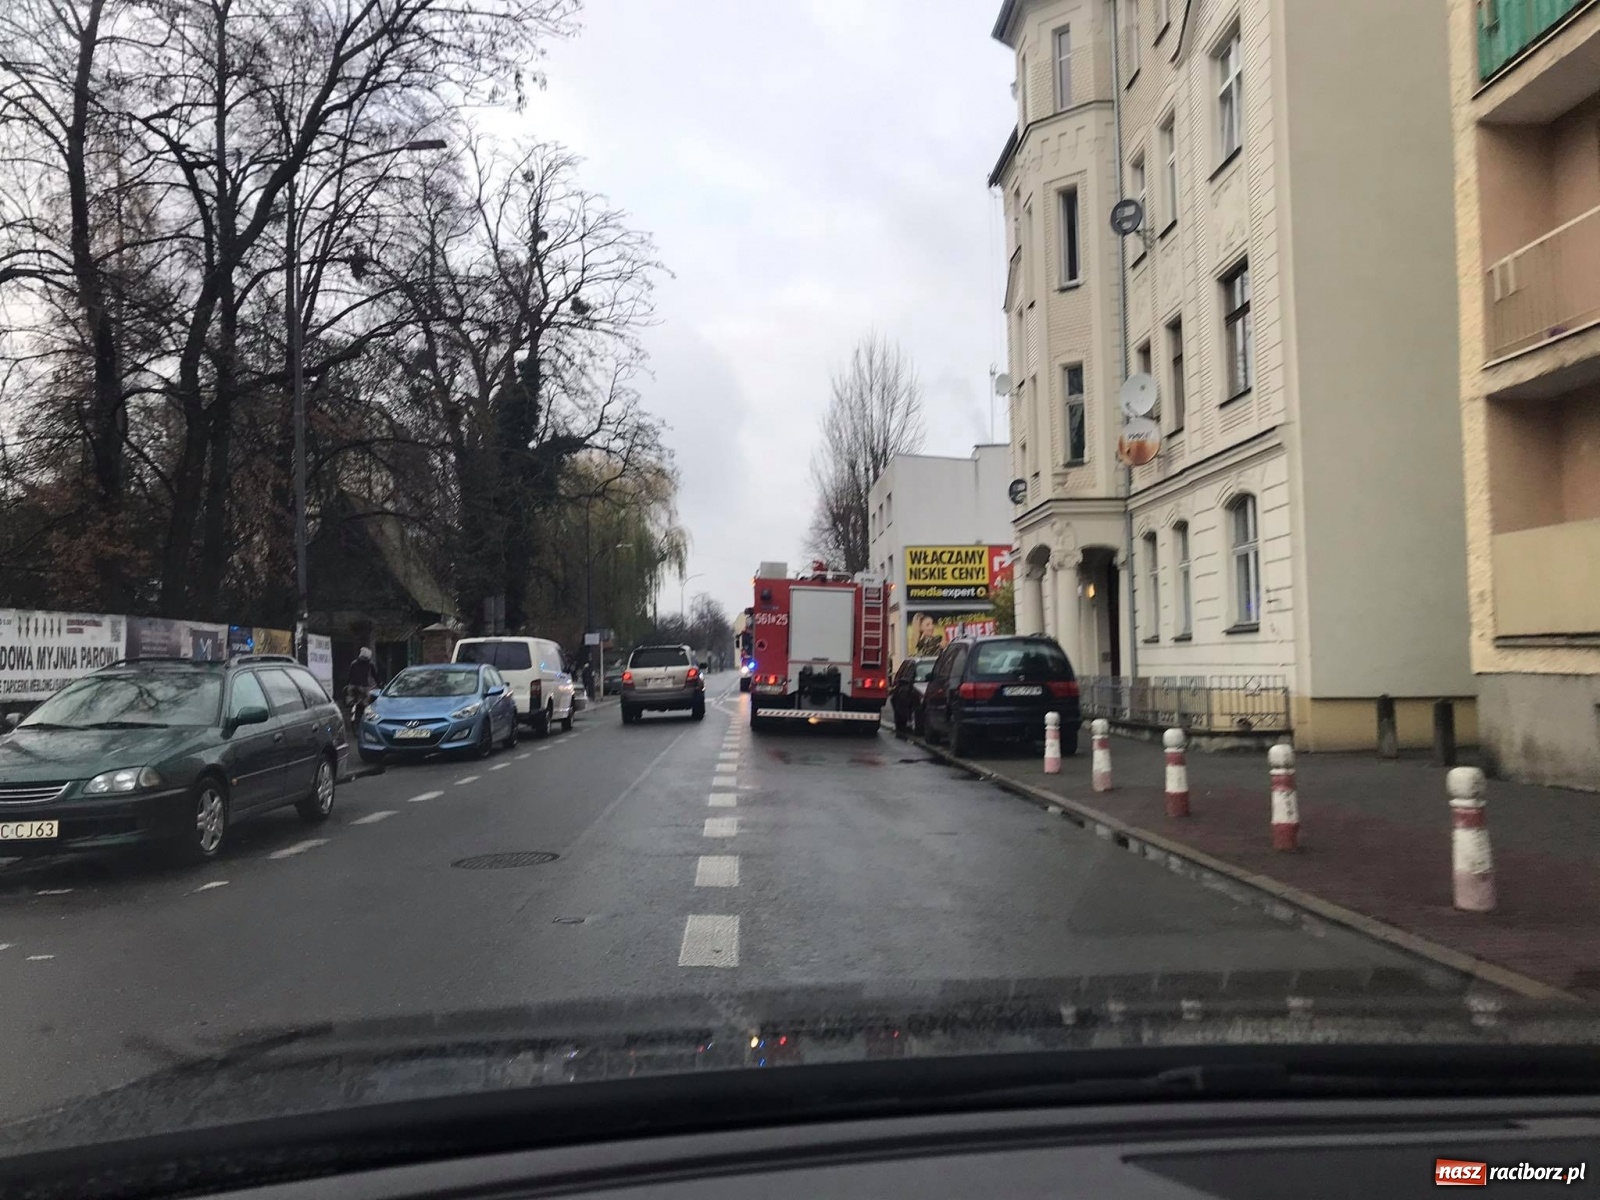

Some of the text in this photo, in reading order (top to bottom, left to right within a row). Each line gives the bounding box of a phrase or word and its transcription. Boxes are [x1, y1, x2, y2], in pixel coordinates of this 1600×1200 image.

[909, 550, 985, 565] WŁĄCZAMY
[909, 567, 986, 580] NISKIE CENY!
[910, 586, 976, 598] mediaexpert
[0, 645, 119, 671] DOWA MYJNIA PAROWA
